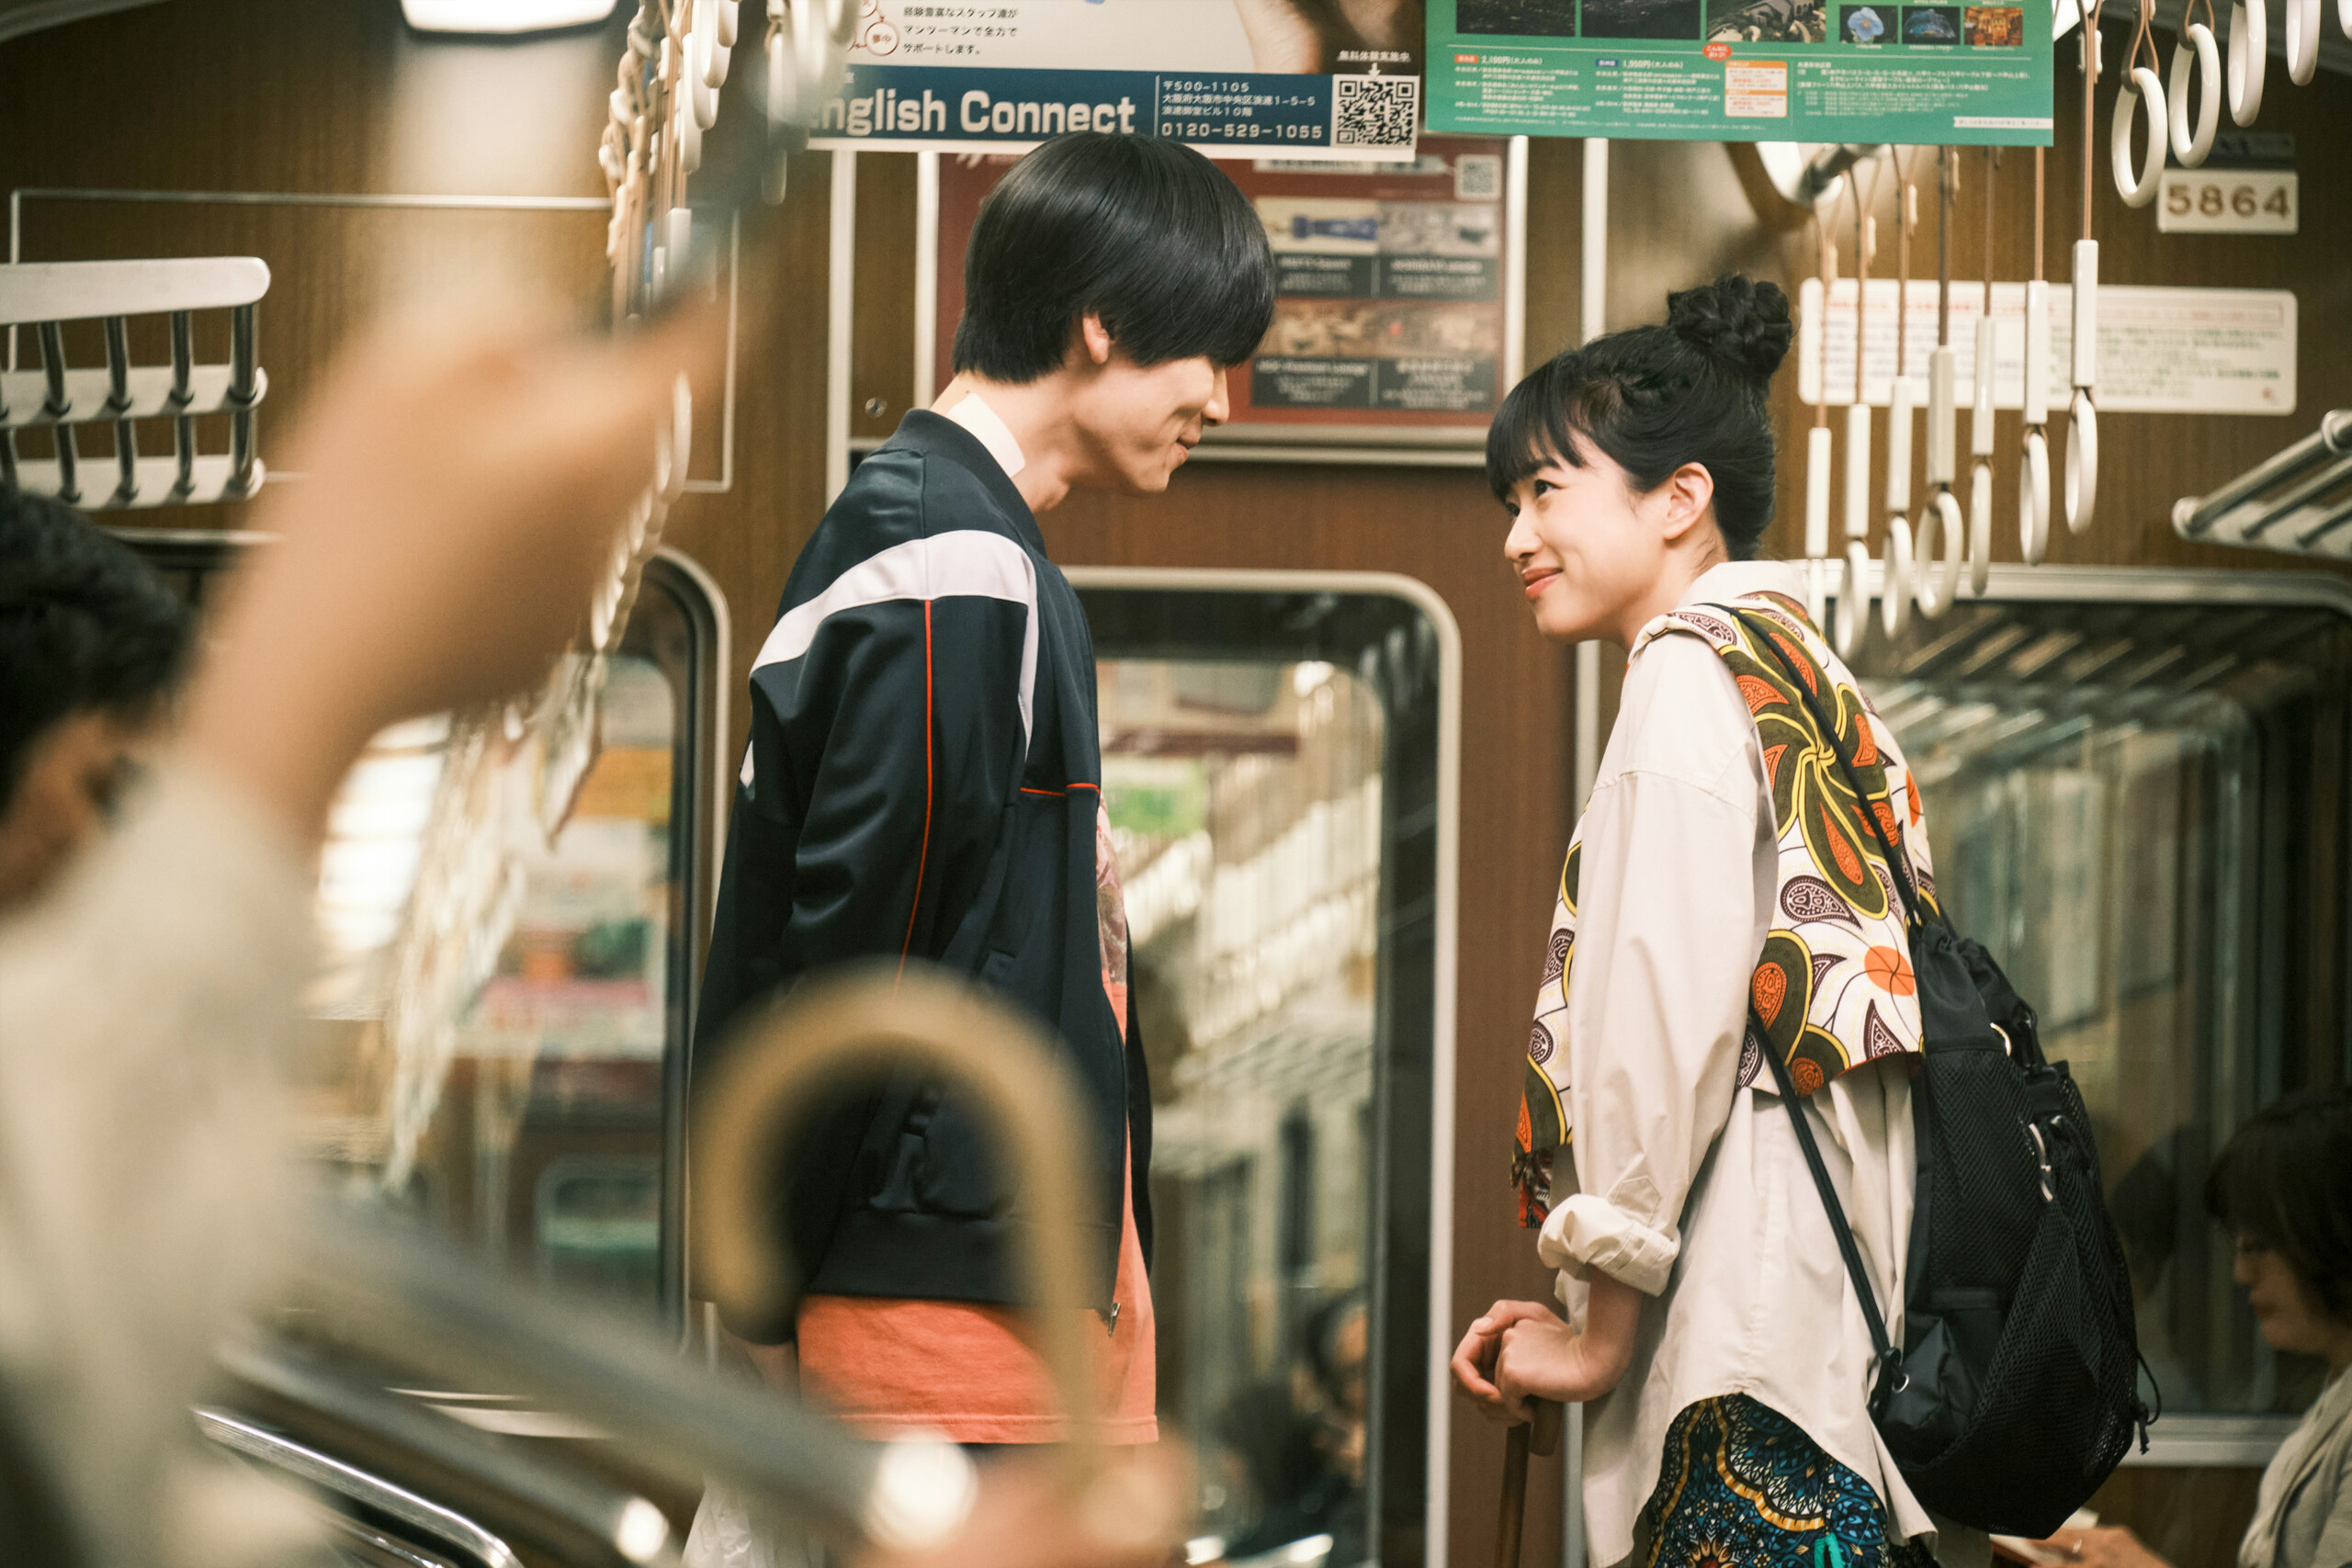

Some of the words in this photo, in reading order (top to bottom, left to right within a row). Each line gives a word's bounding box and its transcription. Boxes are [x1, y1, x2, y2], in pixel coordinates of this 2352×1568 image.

[903, 25, 1019, 37] マンツーマンで全力で
[903, 43, 980, 55] サポートします。
[807, 88, 947, 137] nglish
[960, 89, 1136, 134] Connect
[1161, 122, 1323, 139] 0120-529-1055
[2166, 184, 2290, 220] 5864
